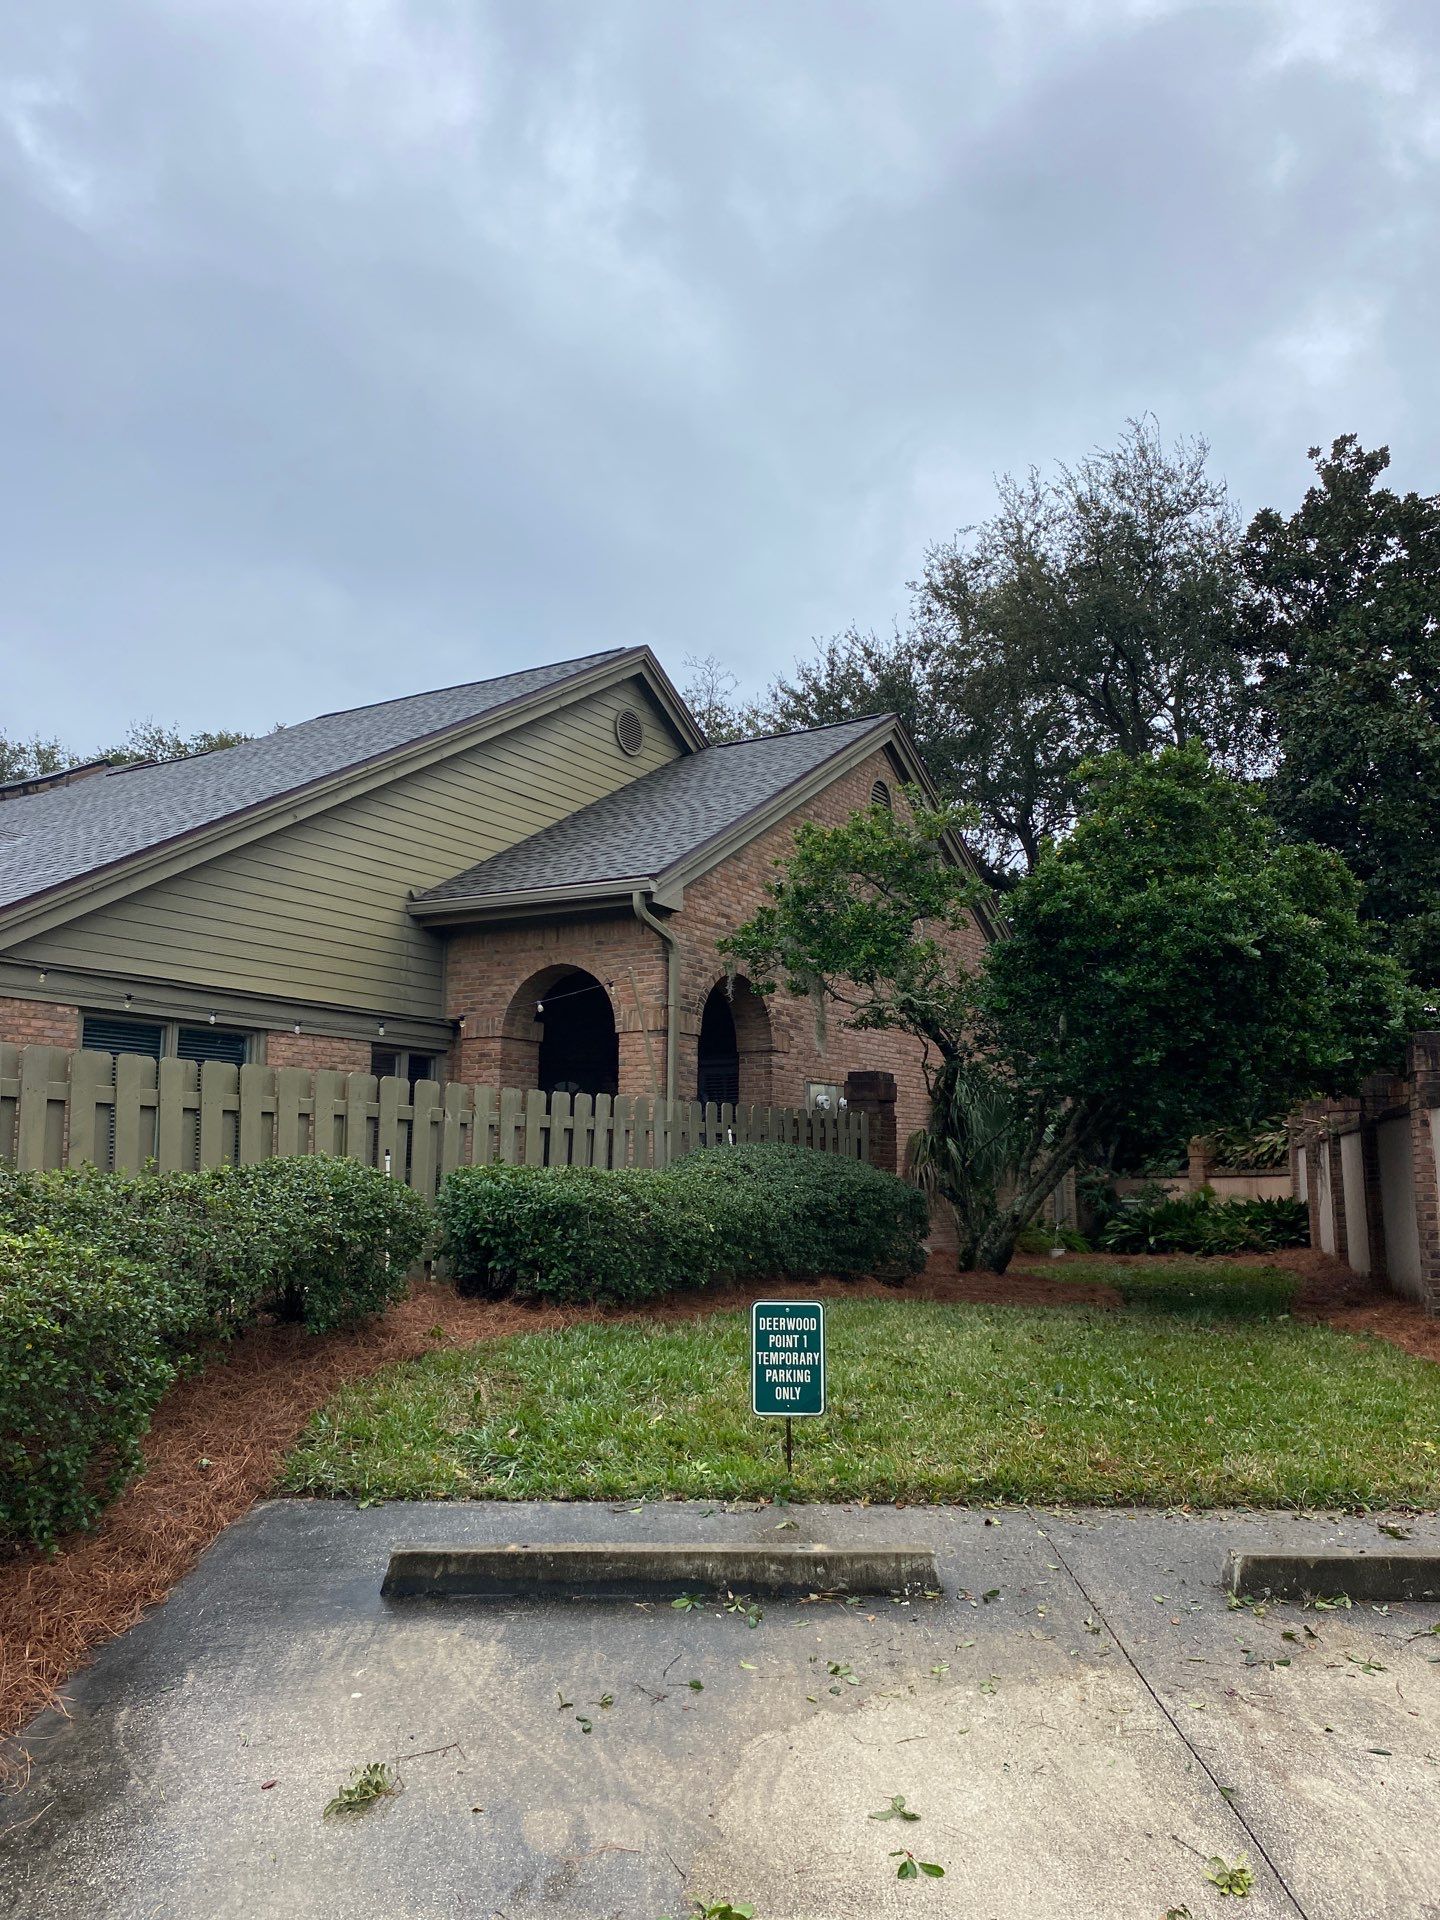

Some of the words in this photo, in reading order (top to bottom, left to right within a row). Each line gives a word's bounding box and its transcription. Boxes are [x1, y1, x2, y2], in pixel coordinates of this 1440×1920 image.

[759, 1317, 817, 1331] DEERWOOD
[768, 1334, 800, 1348] POINT
[802, 1334, 808, 1348] 1
[756, 1351, 820, 1365] TEMPORARY
[765, 1369, 811, 1383] PARKING
[775, 1386, 801, 1400] ONLY
